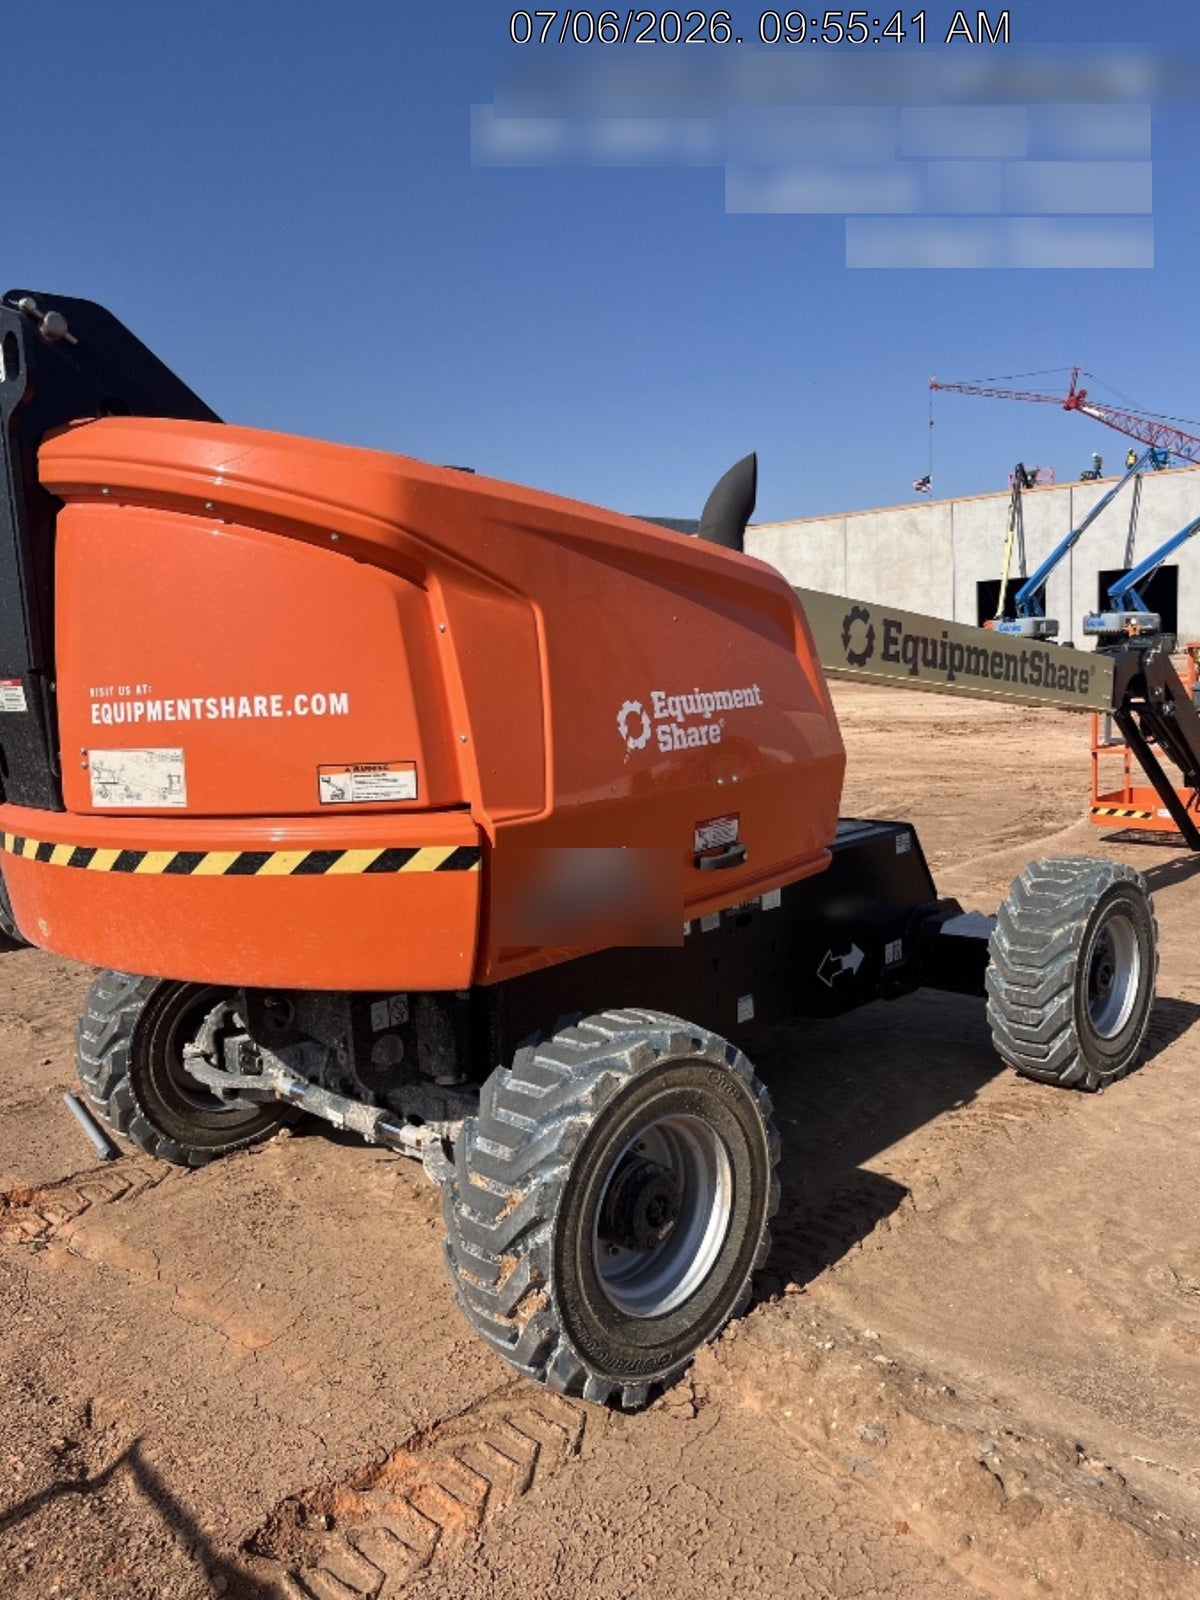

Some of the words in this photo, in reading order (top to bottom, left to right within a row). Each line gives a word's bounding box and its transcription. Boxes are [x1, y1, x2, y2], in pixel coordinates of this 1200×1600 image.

[882, 618, 1090, 695] EquipmentShare
[118, 685, 131, 697] US
[136, 683, 152, 696] AT:
[650, 684, 763, 722] Equipment
[91, 693, 349, 725] EQUIPMENTSHARE.COM
[656, 723, 721, 752] Share
